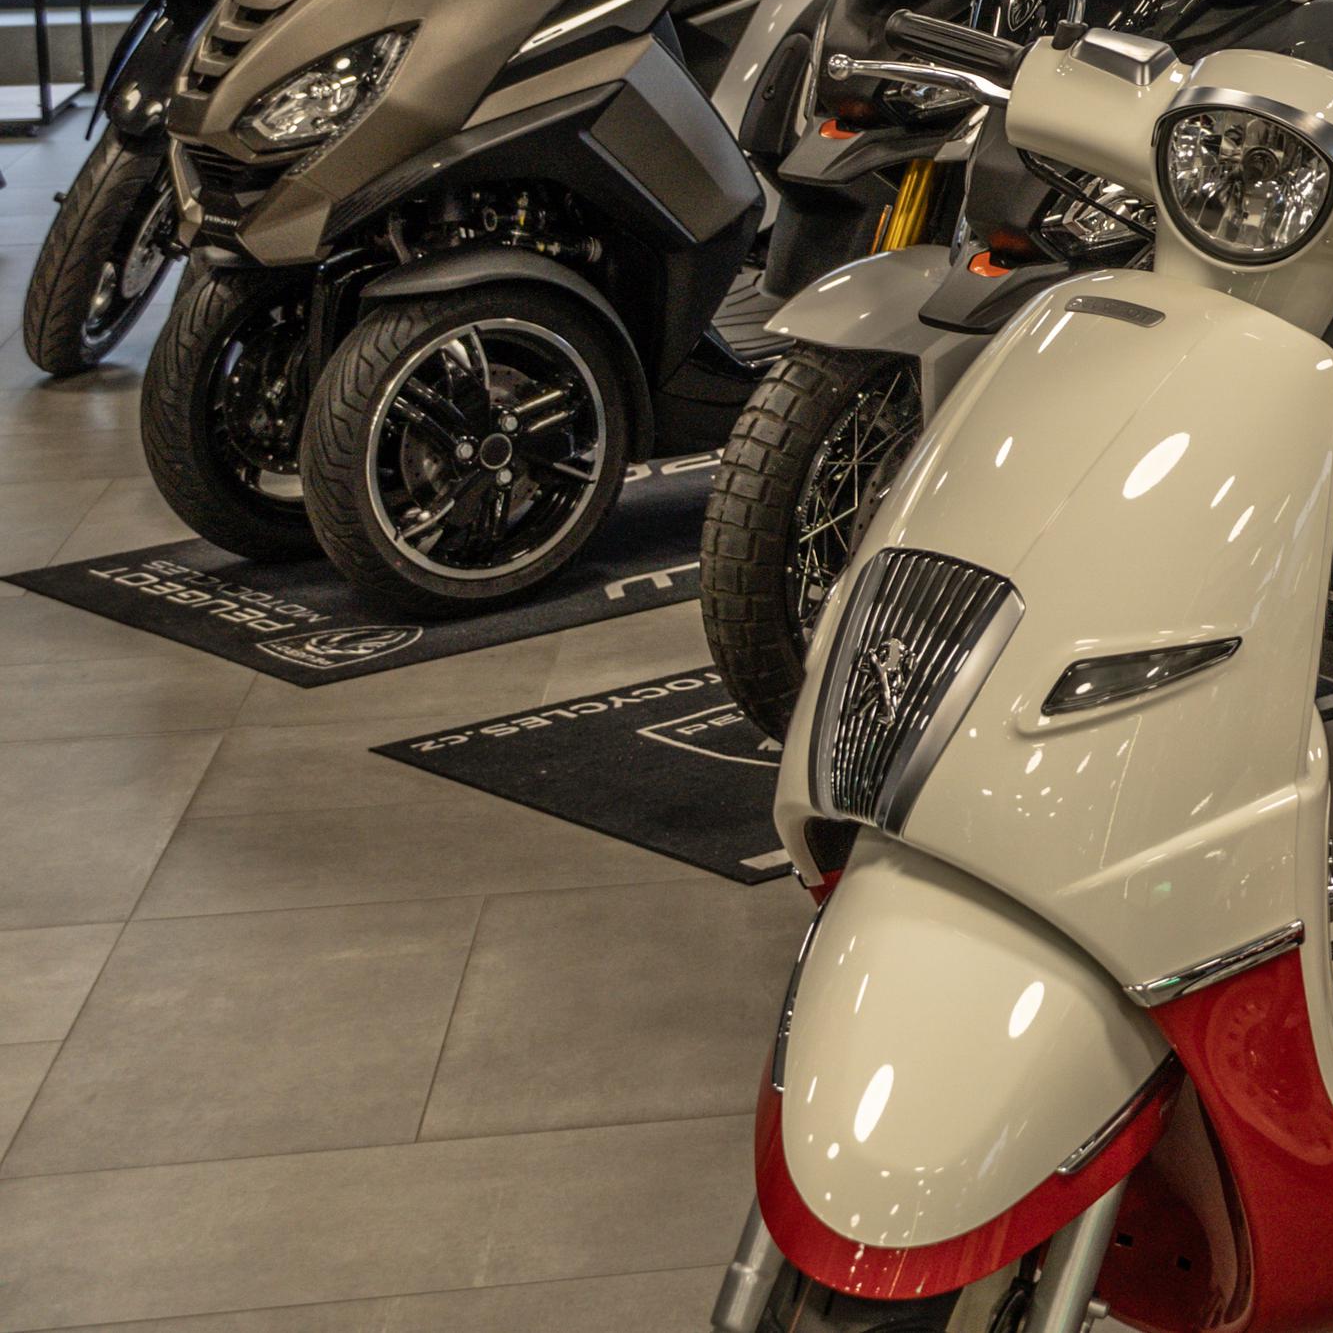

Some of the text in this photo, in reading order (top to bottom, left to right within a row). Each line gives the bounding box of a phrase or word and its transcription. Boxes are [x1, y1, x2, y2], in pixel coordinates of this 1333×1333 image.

[88, 567, 296, 633] PEUGEOT
[142, 559, 333, 624] MOTOCYCLES
[410, 671, 724, 753] TOCYCLES.cz
